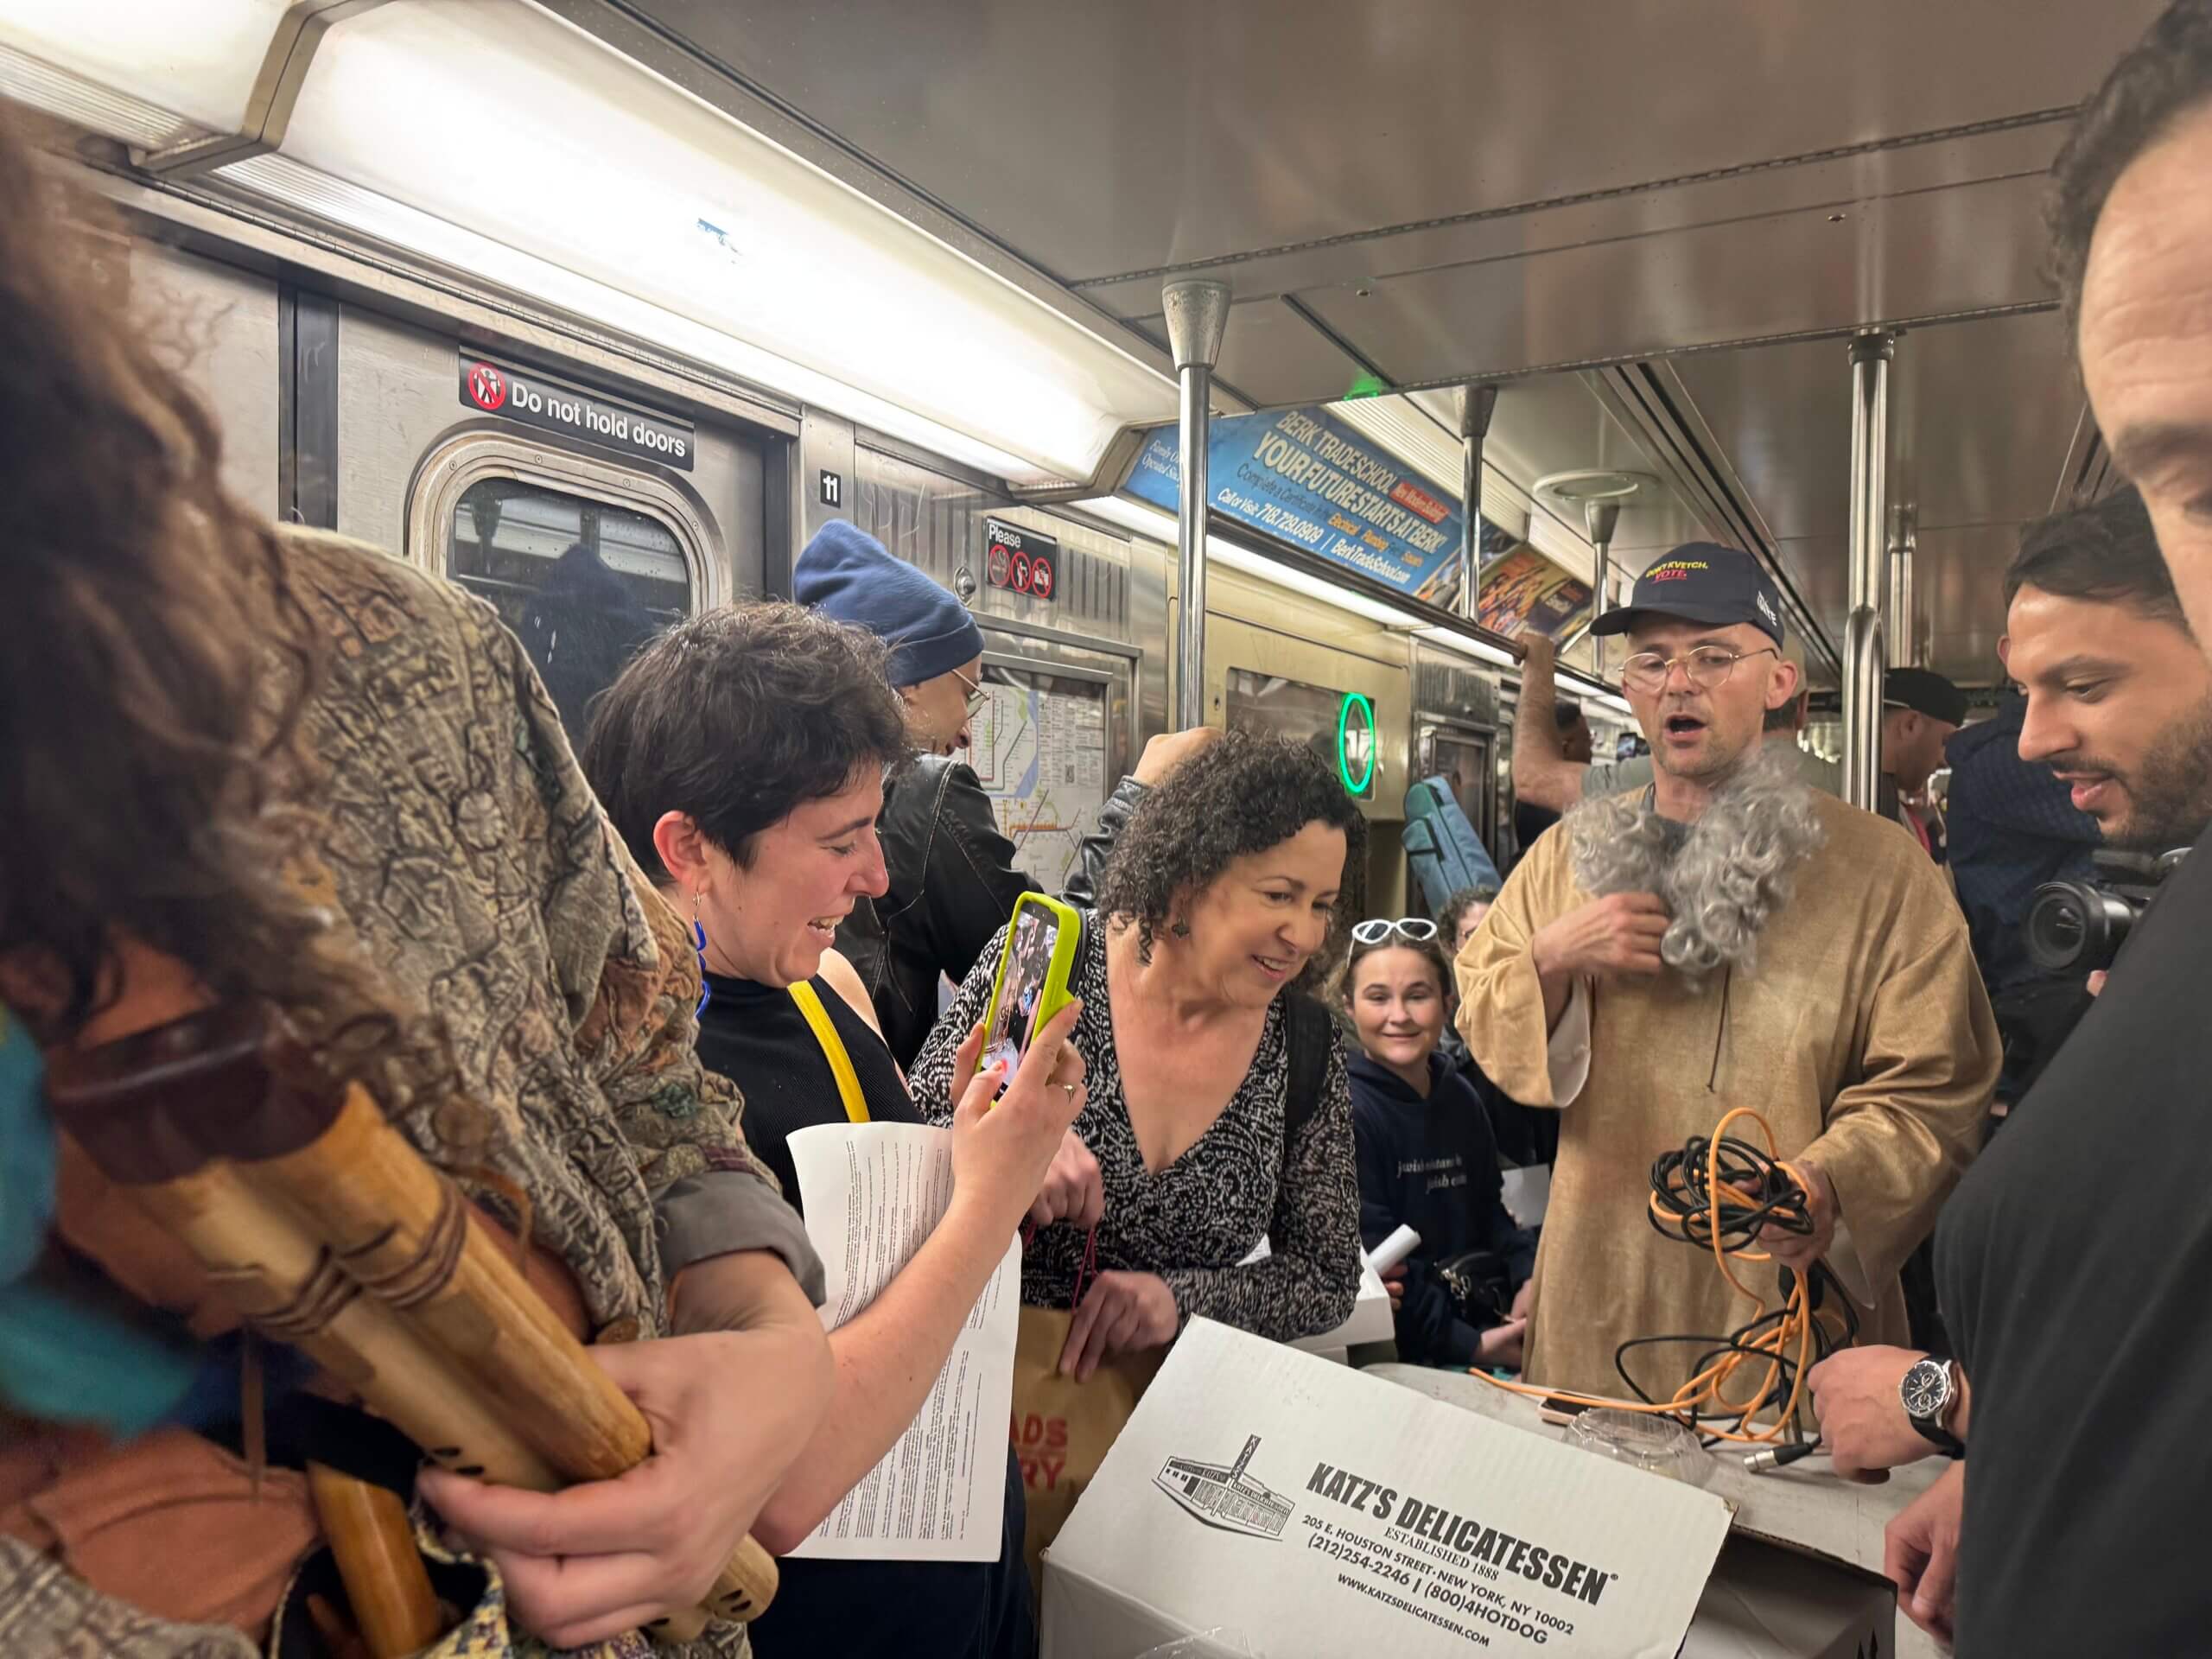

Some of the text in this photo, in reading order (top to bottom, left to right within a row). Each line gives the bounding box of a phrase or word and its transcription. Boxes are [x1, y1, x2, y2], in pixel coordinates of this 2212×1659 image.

[512, 381, 686, 457] Do not hold doors
[1276, 410, 1398, 494] BERK TRADE SCHOOL
[823, 475, 838, 502] 11
[1254, 431, 1311, 481] YOUR
[1298, 461, 1364, 508] FUTURE
[1351, 491, 1407, 534] STARTS
[1393, 516, 1421, 539] AT
[988, 523, 1021, 549] Please
[1306, 1462, 1610, 1605] KATZ'S DELICATESSEN
[1383, 1527, 1499, 1581] ESTABLISHED 1888
[1302, 1515, 1323, 1530] 205
[1336, 1528, 1393, 1559] HOUSTON
[1437, 1569, 1468, 1589] NEW
[1471, 1583, 1506, 1609] YORK,
[1510, 1600, 1532, 1616] NY
[1535, 1610, 1574, 1636] 10002
[1308, 1533, 1412, 1586] (212)254-2246
[1424, 1581, 1548, 1644] (800)4HOTDOG
[1338, 1573, 1491, 1647] WWW.KATZSDELICATESSEN.COM
